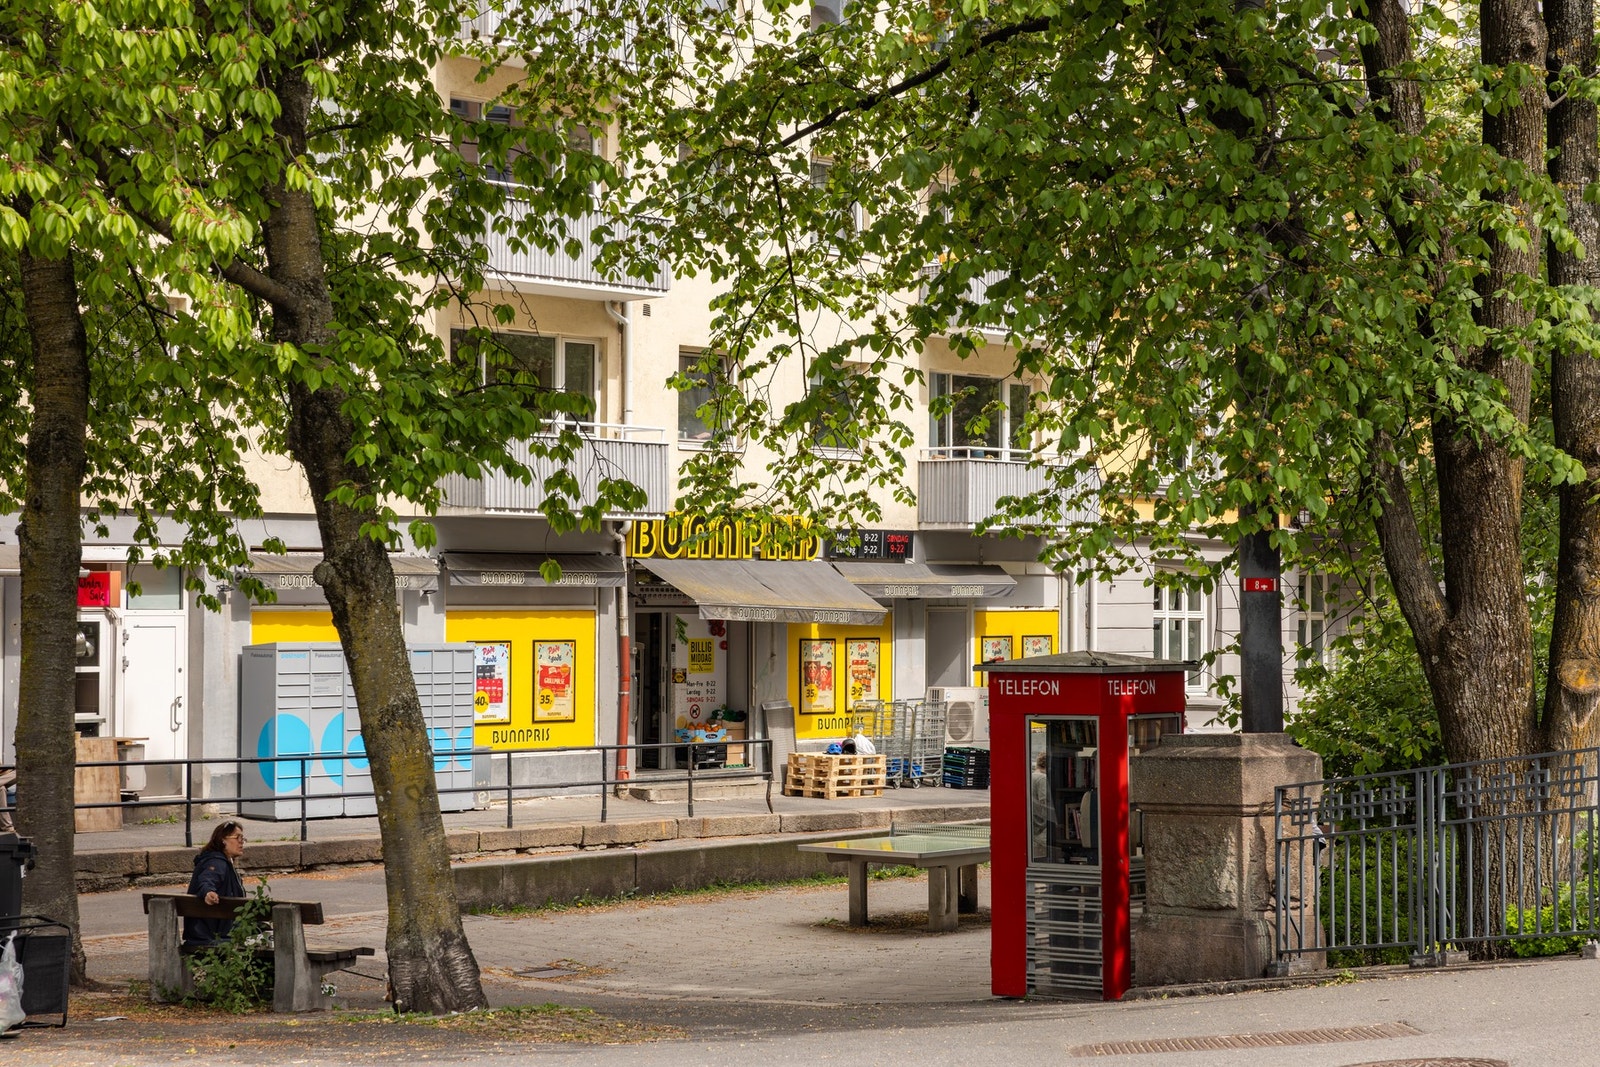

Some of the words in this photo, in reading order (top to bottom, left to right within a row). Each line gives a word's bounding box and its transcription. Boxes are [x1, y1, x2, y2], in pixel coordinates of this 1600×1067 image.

[865, 534, 878, 542] 8-22
[864, 546, 877, 554] 9-22
[890, 545, 904, 553] 9-22
[481, 572, 525, 584] BUNNPRIS
[885, 585, 919, 596] BUNNPRIS
[951, 585, 984, 596] BUNNPRIS
[1254, 580, 1260, 590] 8
[738, 608, 777, 621] BUNNPRIS
[813, 610, 850, 623] BUNNPRIS
[690, 641, 712, 652] BILLIG
[999, 680, 1060, 695] TELEFON
[1108, 679, 1156, 695] TELEFON
[492, 728, 550, 744] BUNNPRIS
